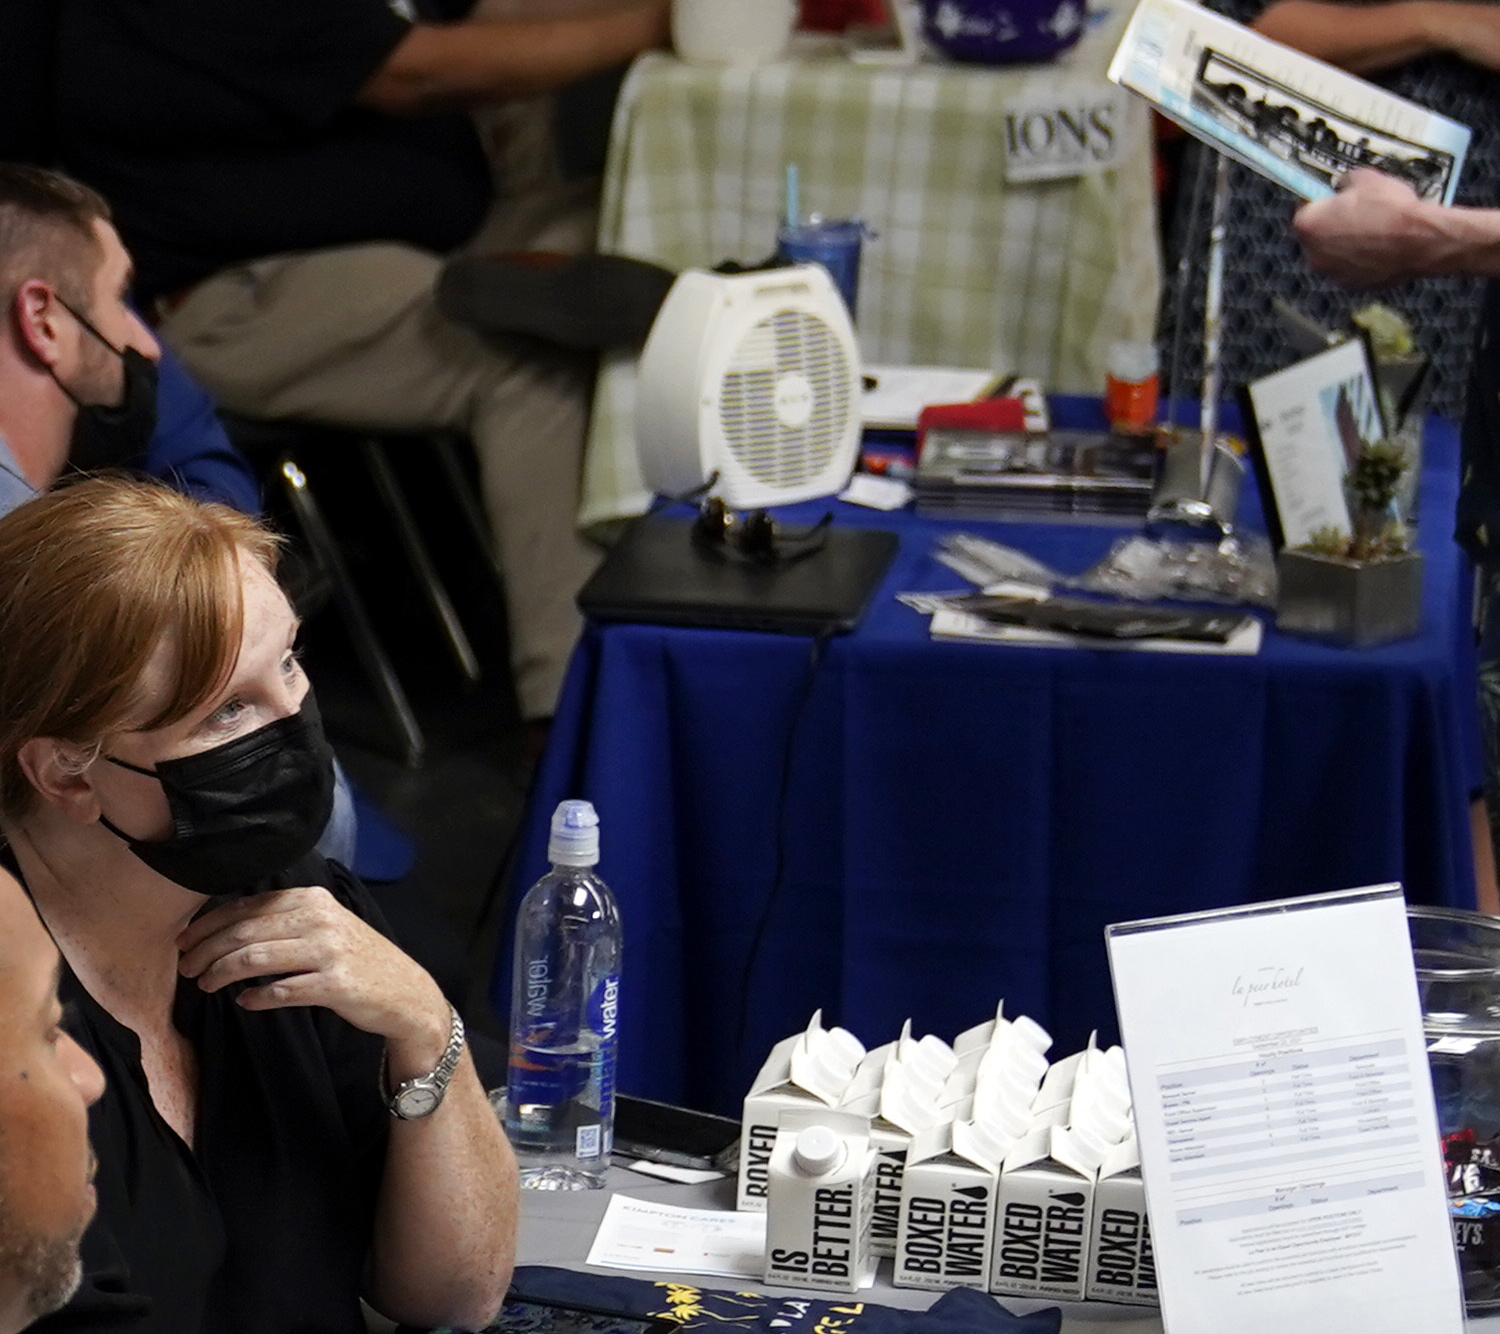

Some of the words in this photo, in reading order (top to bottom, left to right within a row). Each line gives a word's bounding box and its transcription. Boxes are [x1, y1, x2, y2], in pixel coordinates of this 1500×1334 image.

[771, 1248, 809, 1274] IS
[811, 1183, 853, 1277] BETTER.
[904, 1197, 946, 1275] BOXED
[944, 1199, 987, 1276] WATER
[1000, 1202, 1043, 1280] BOXED
[1040, 1205, 1085, 1283] WATER
[1096, 1208, 1140, 1287] BOXED
